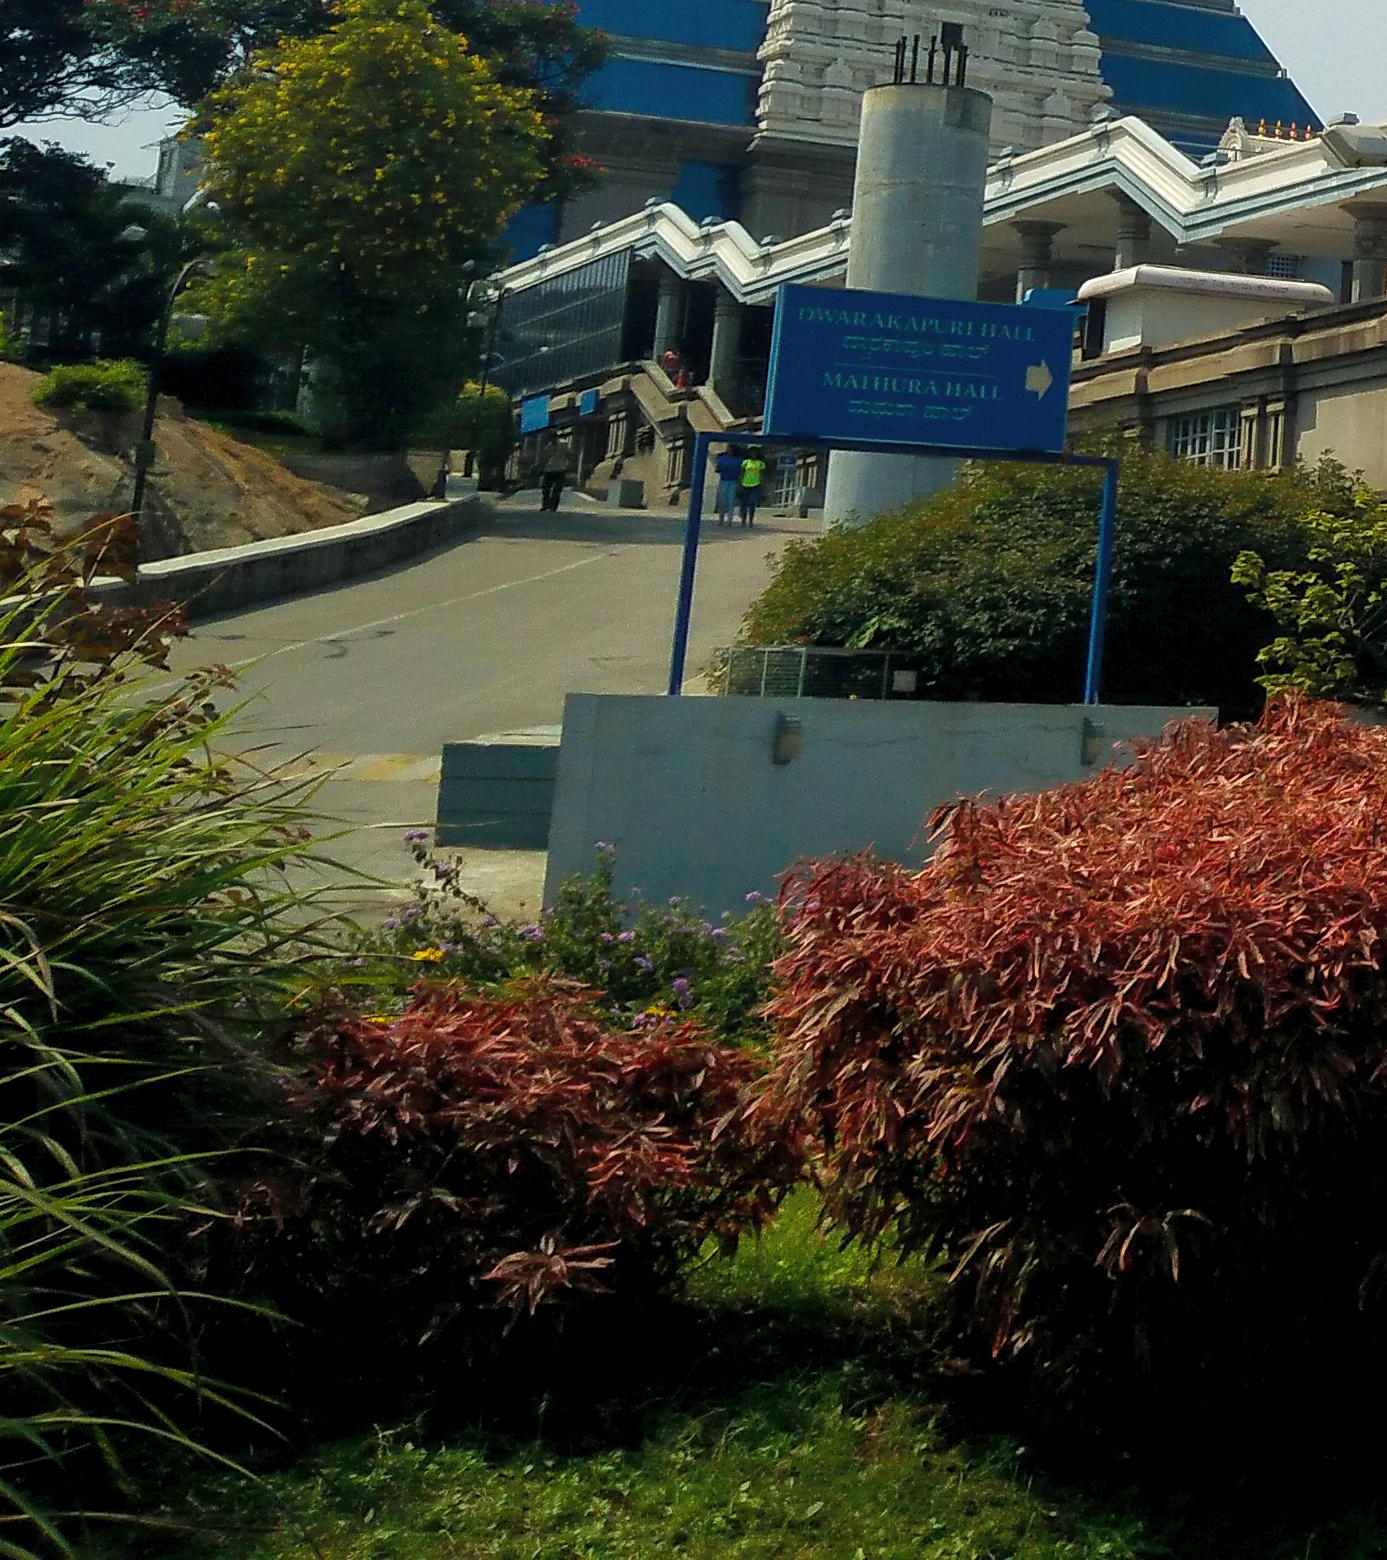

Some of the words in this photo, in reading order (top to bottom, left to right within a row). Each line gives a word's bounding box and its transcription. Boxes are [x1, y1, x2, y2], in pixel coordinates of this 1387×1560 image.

[981, 323, 1036, 342] HALL
[822, 372, 939, 396] MATHURA
[944, 381, 1003, 400] HALL
